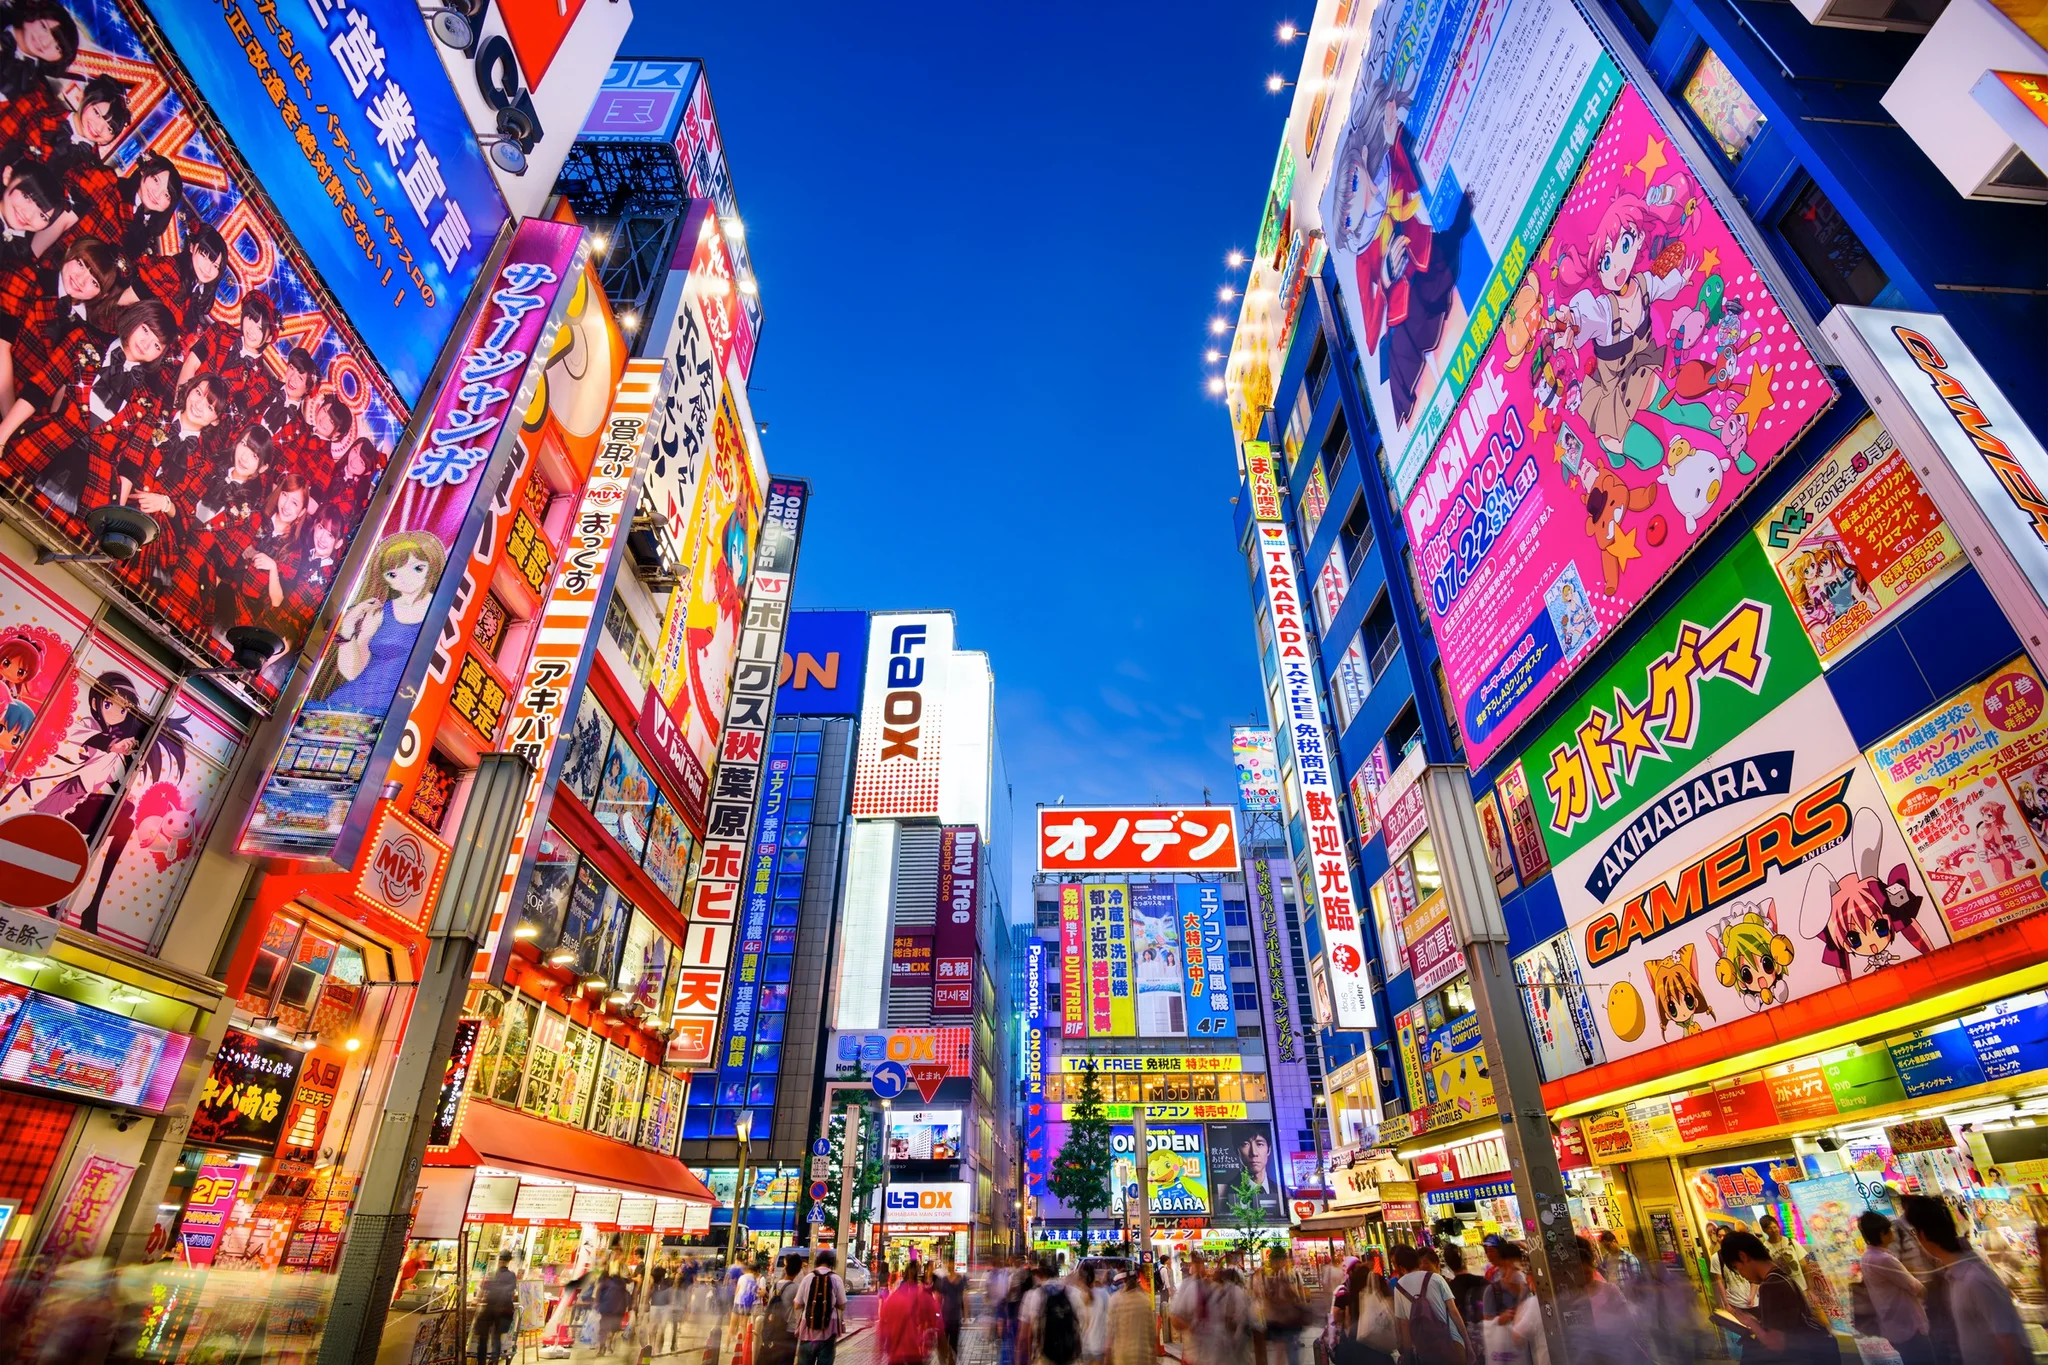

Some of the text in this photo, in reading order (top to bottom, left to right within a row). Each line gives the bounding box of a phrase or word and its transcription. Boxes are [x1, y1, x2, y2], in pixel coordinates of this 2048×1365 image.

[1555, 72, 1613, 180] 開催中!!
[1538, 175, 1557, 204] 2015
[408, 262, 558, 488] サマージャンボ
[600, 419, 643, 478] 買取り
[1409, 357, 1510, 541] PUNCH LINE
[1464, 405, 1524, 498] Vol.1
[1250, 456, 1279, 519] まんが喫茶
[1814, 431, 1894, 513] 2015年5月号
[1486, 481, 1505, 513] ON
[1489, 455, 1539, 535] SALE!!
[1854, 484, 1912, 537] なのはViVid
[758, 483, 787, 568] PARADISE
[782, 484, 805, 542] HOBBY
[1866, 499, 1914, 545] オリジナル
[514, 509, 551, 573] 現金
[565, 512, 609, 595] まっくす
[506, 529, 548, 595] 買取
[1424, 538, 1450, 580] DVD
[1431, 503, 1494, 614] 07.22
[1266, 551, 1306, 658] TAKARADA
[1804, 569, 1855, 617] SAMPLE
[460, 653, 506, 716] 高額
[1985, 677, 2034, 714] 第7巻
[449, 681, 498, 743] 査定
[2004, 705, 2041, 731] 発売中!
[2005, 698, 2028, 716] 好評
[1875, 703, 1973, 770] 俺がお嬢様学校に
[773, 760, 787, 769] 6F
[1295, 723, 1328, 785] 免税商店
[1914, 730, 2000, 785] として拉致られた件
[669, 744, 687, 776] Doll
[683, 767, 702, 803] Point
[1044, 811, 1230, 863] オノデン
[1401, 815, 1425, 849] TAKARADA
[1602, 760, 1767, 888] AKIHABARA
[760, 845, 776, 856] 5F
[1306, 791, 1355, 932] 歓迎光臨
[1801, 836, 1845, 864] ANIBRO
[1978, 836, 2030, 862] SAMPLE
[952, 831, 976, 924] Duty Free
[1586, 770, 1855, 968] GAMERS
[941, 873, 953, 902] Store
[1998, 880, 2034, 898] 980円+税
[744, 941, 761, 953] 4F
[893, 948, 931, 958] 総合家電
[894, 938, 913, 948] 本店
[939, 961, 969, 976] 免税
[1062, 888, 1083, 1035] 免税 DUTYFREE B1F
[1429, 956, 1459, 986] TAKARADA
[937, 989, 969, 1001] 면세점
[1028, 945, 1042, 1019] Panasonic
[1341, 992, 1349, 1013] Shop
[1994, 1003, 2009, 1015] 6F
[1197, 1018, 1226, 1033] 4F
[1397, 1014, 1410, 1029] 2F
[218, 1046, 294, 1080] ここから始まる伝説
[1030, 1029, 1042, 1093] ONODEN
[1069, 1058, 1181, 1071] TAX FREE 免税店
[1432, 1046, 1442, 1062] 2F
[1785, 1064, 1796, 1074] 3F
[1847, 1049, 1856, 1058] 4F
[303, 1058, 340, 1089] 入口
[917, 1071, 942, 1081] 止まれ
[1828, 1067, 1841, 1077] CD
[1834, 1080, 1852, 1092] DVD
[296, 1087, 333, 1108] はコチラ
[1146, 1106, 1189, 1117] エアコン
[1426, 1099, 1454, 1117] DISCOUNT
[1378, 1117, 1400, 1132] DISCOUNT
[1378, 1130, 1406, 1144] COMPUTERS
[1424, 1110, 1463, 1130] GSM MOBILES
[191, 1178, 235, 1205] 2F
[1605, 1182, 1624, 1228] TAX
